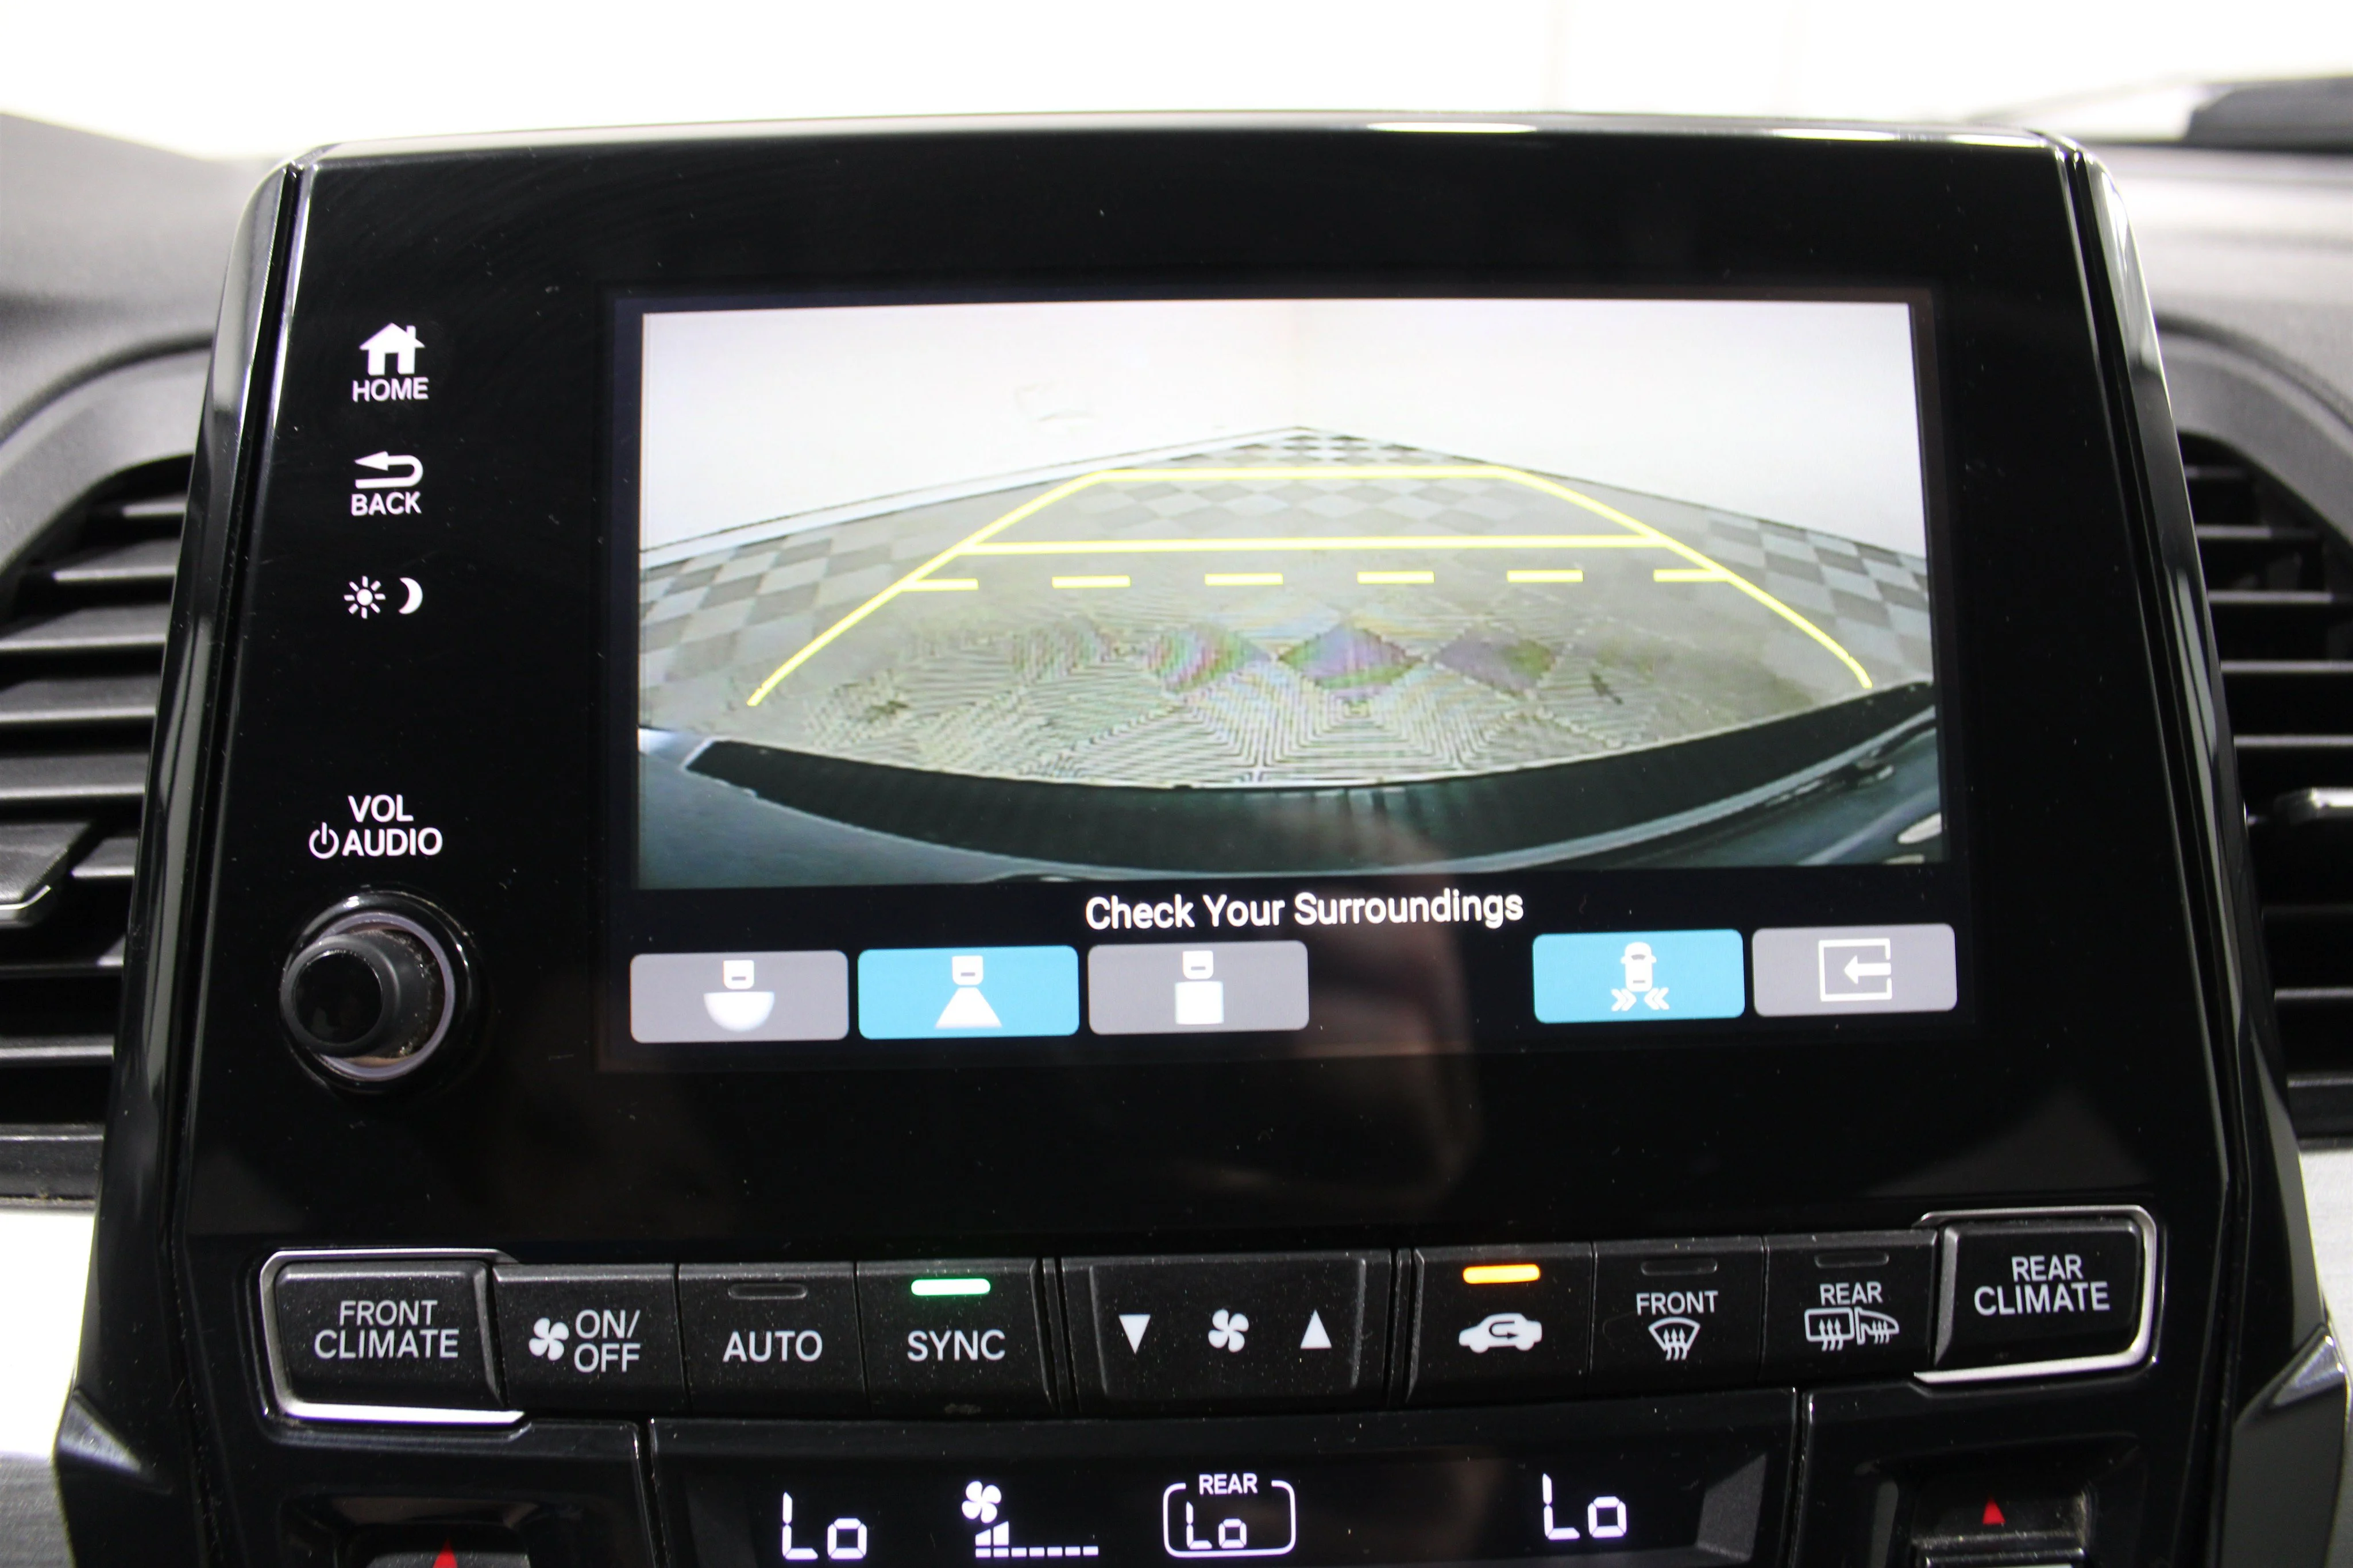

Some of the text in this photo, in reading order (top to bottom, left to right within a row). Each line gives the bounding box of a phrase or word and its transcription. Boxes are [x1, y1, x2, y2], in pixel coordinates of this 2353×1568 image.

[352, 376, 429, 402] HOME
[350, 491, 422, 516] BACK
[348, 794, 414, 822] VOL
[342, 827, 443, 857] AUDIO
[1085, 887, 1524, 930] Check Your Surroundings
[2011, 1254, 2084, 1281] REAR
[1636, 1290, 1718, 1315] FRONT
[1819, 1281, 1883, 1306] REAR
[1974, 1281, 2110, 1316] CLIMATE
[339, 1300, 438, 1326] FRONT
[575, 1309, 641, 1339] ON/
[314, 1328, 460, 1360] CLIMATE
[574, 1342, 641, 1373] OFF
[723, 1330, 823, 1362] AUTO
[907, 1329, 1005, 1362] SYNC
[1199, 1472, 1258, 1496] REAR
[1542, 1473, 1627, 1541] Lo
[781, 1492, 867, 1562] Lo
[1186, 1502, 1248, 1550] Lo
